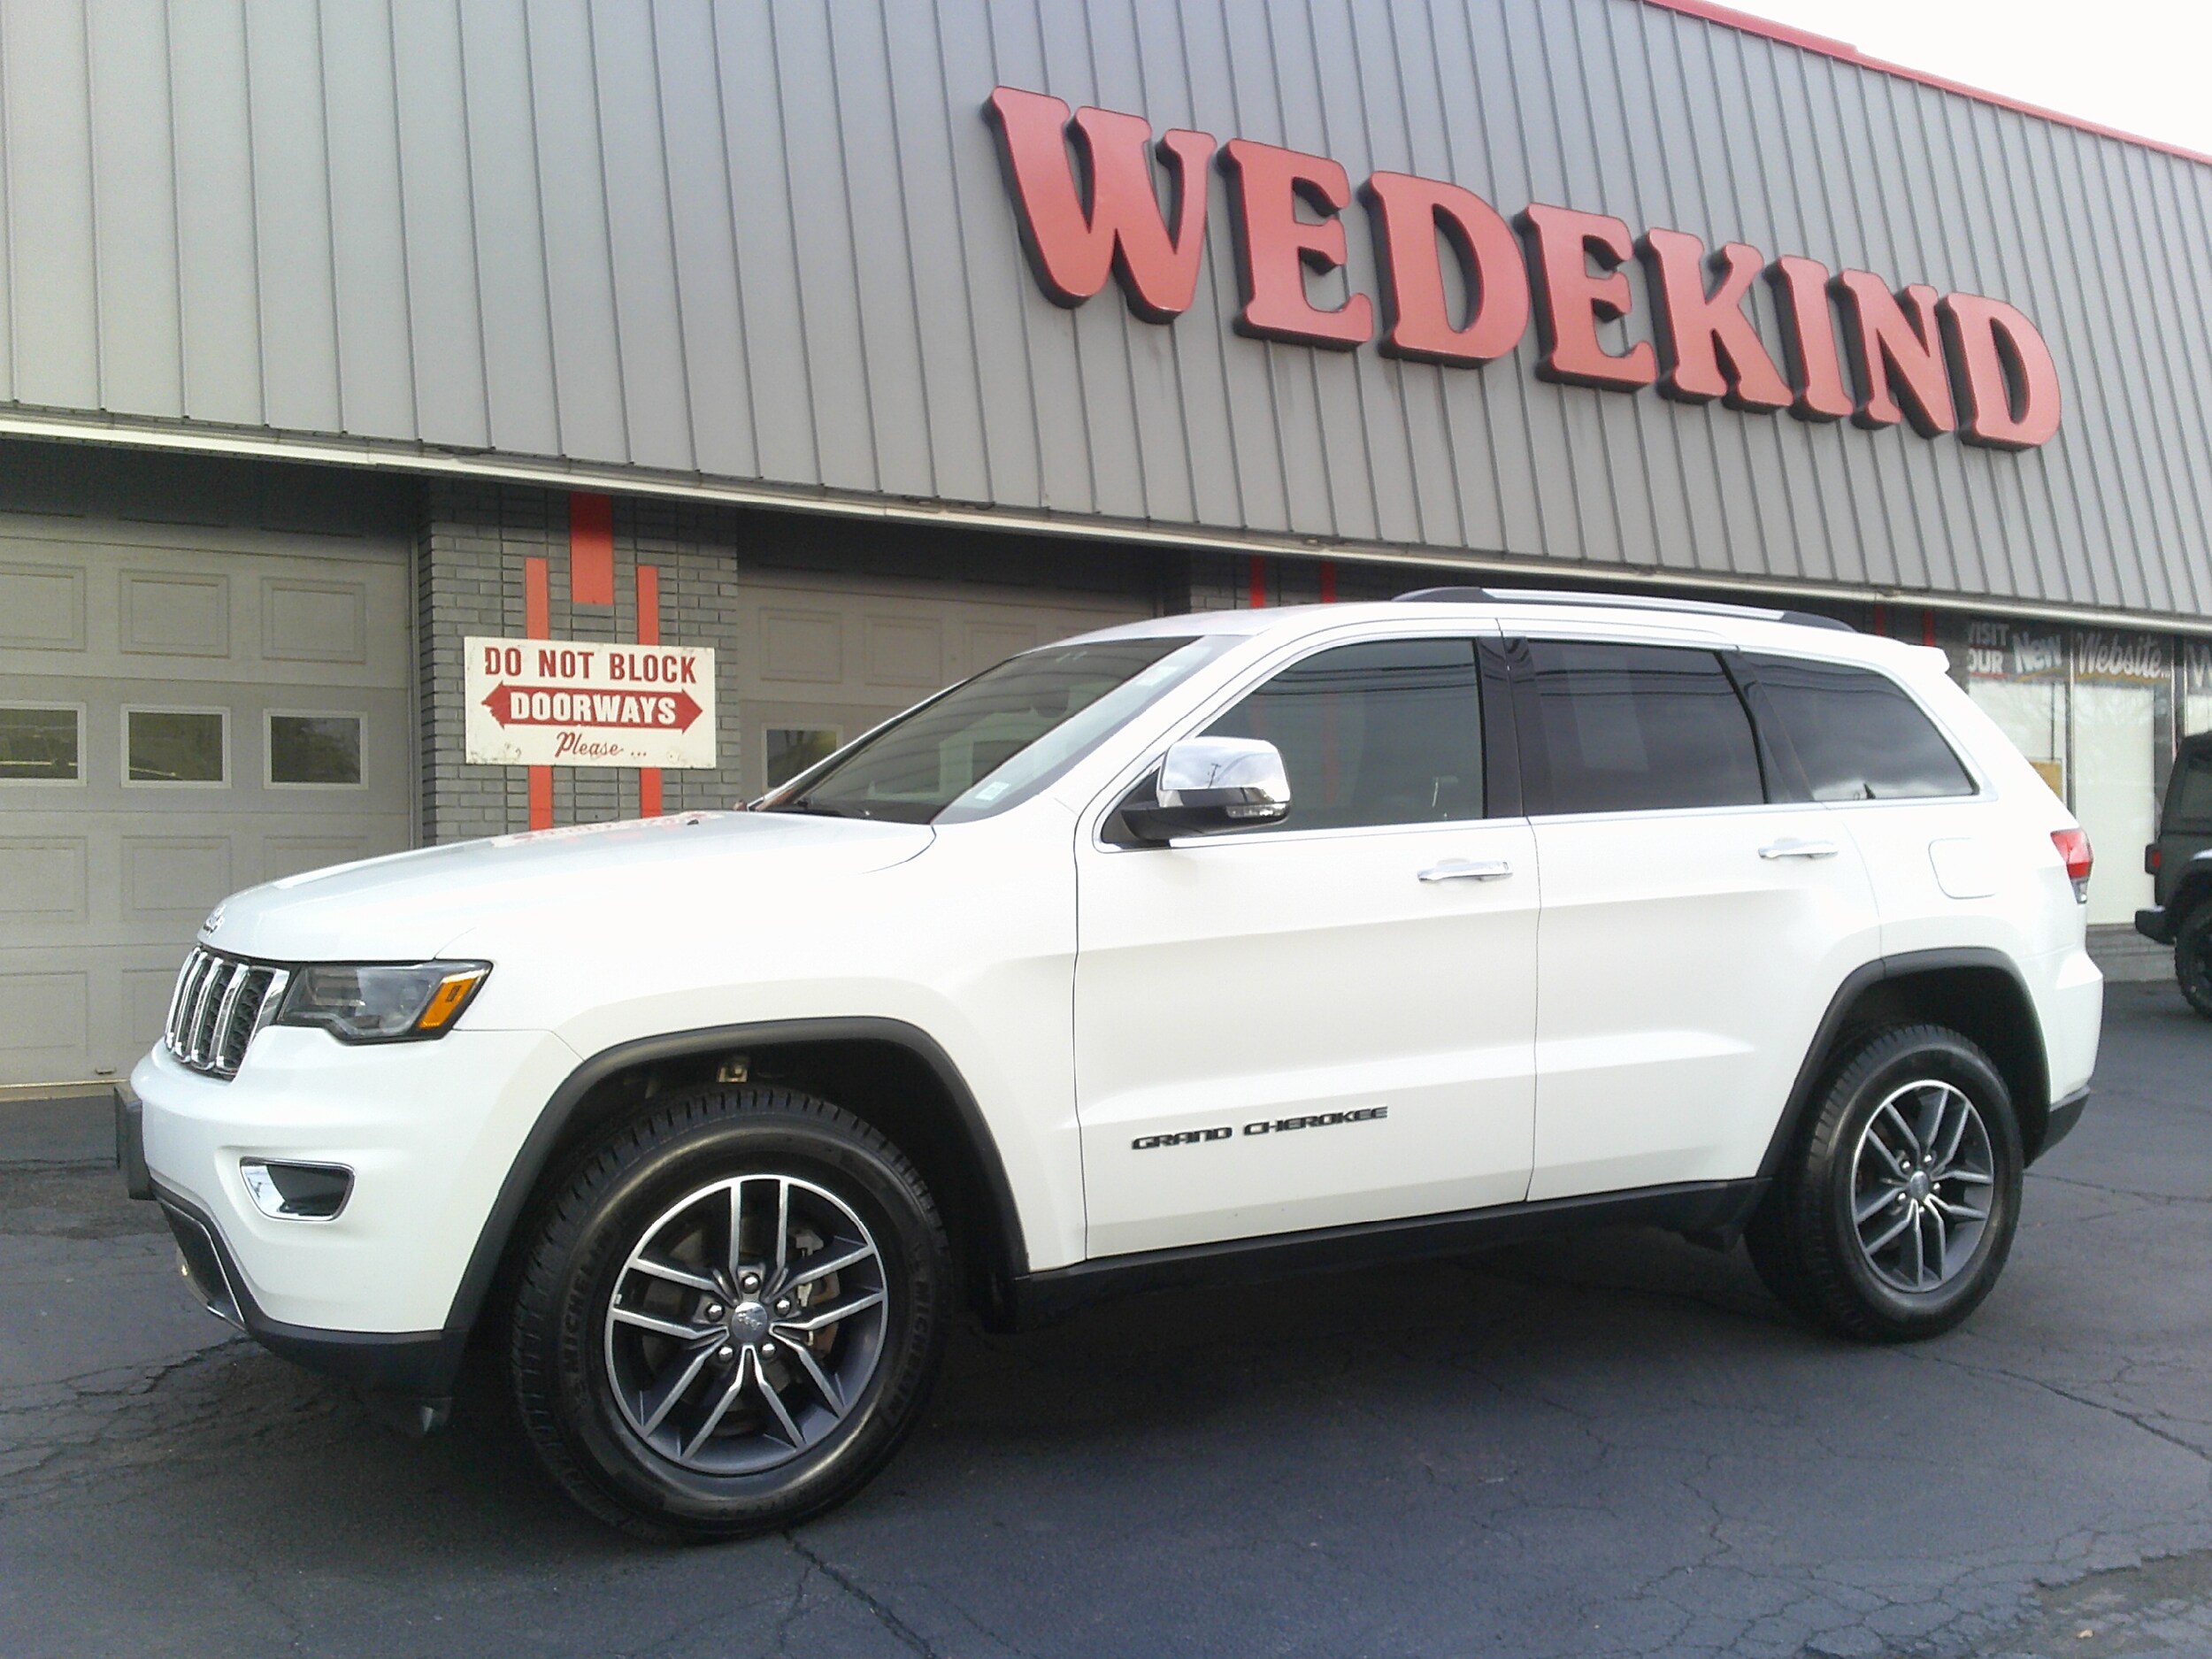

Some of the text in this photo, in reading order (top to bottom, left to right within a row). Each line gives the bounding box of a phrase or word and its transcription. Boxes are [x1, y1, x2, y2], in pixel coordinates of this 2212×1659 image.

[983, 86, 2062, 451] WEDEKIND
[484, 647, 696, 684] DO NOT BLOCK
[510, 690, 676, 725] DOORWAYS
[1132, 1105, 1388, 1150] GRAND CHEROKEE
